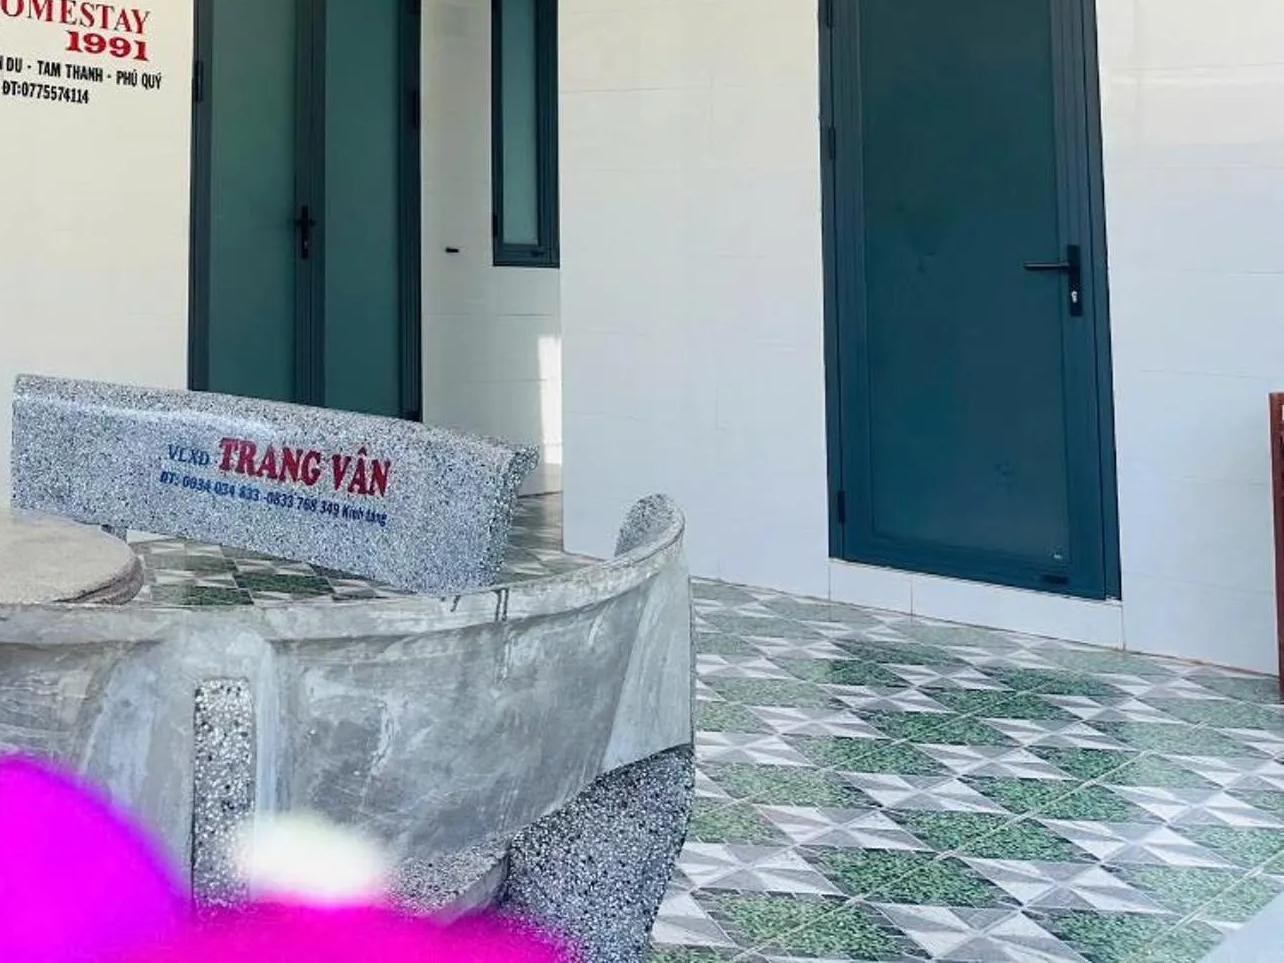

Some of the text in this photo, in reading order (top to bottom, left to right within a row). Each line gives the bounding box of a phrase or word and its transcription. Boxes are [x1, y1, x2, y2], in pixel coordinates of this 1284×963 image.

[65, 30, 149, 61] 1991
[37, 60, 61, 78] TAM
[65, 63, 104, 83] THANH
[141, 72, 162, 90] QUÝ
[218, 436, 322, 487] TRANG
[331, 444, 392, 497] VÂN
[319, 499, 341, 517] 349
